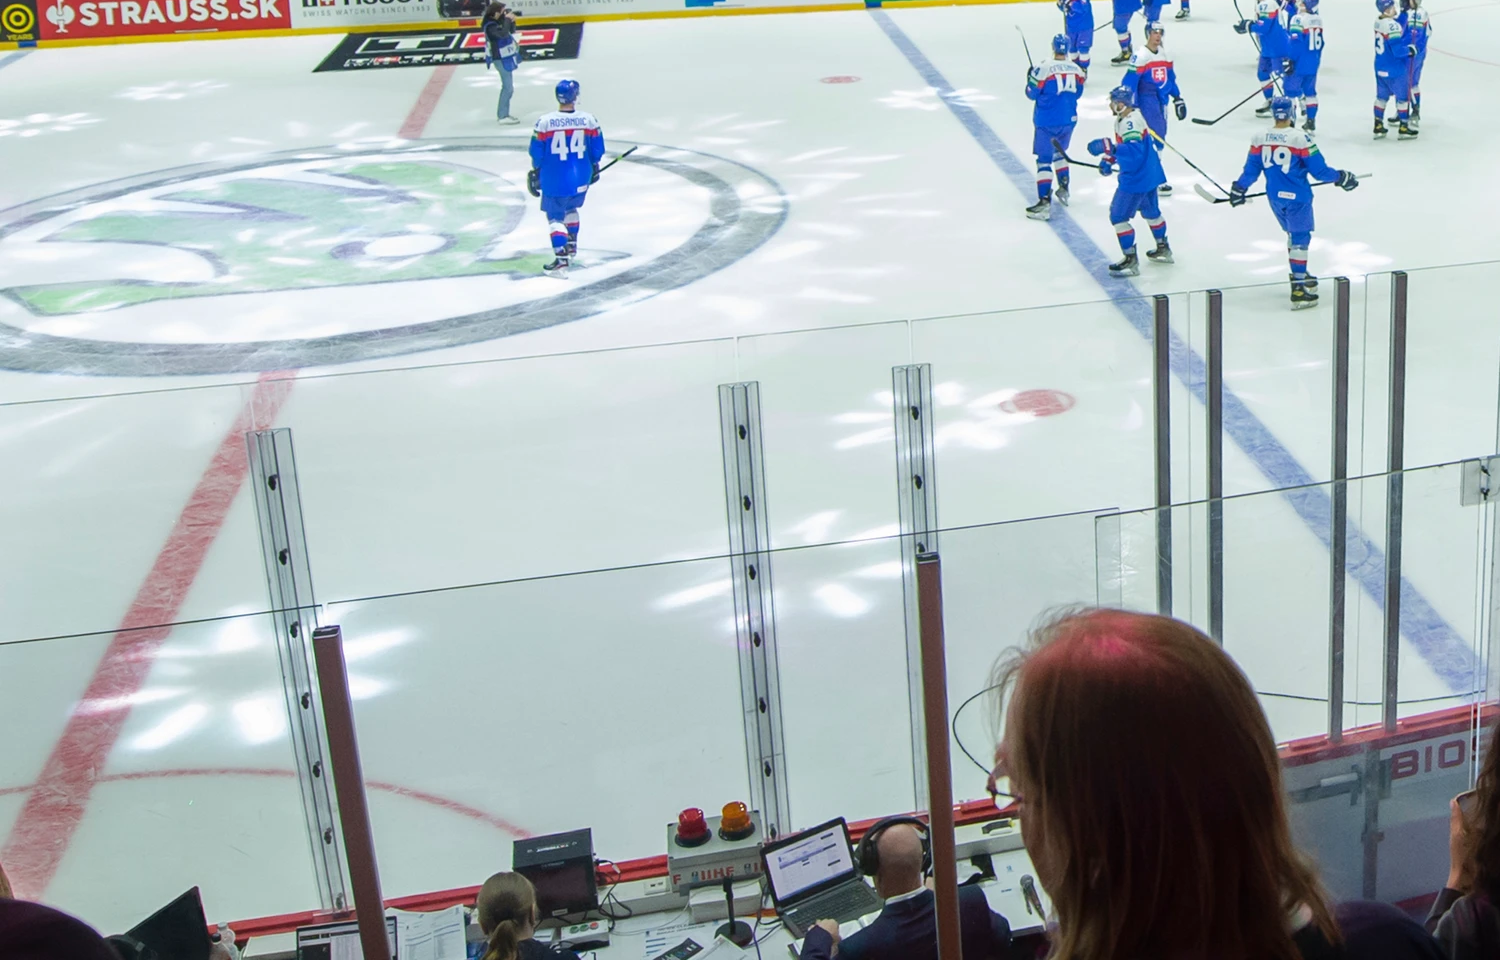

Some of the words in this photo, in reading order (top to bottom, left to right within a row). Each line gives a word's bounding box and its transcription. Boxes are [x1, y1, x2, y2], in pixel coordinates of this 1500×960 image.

[511, 0, 539, 9] SWISS
[303, 10, 332, 19] SWISS
[335, 8, 377, 17] WATCHES
[381, 5, 407, 14] SINCE
[6, 33, 35, 41] YEARS
[1308, 28, 1323, 51] 16
[1054, 73, 1077, 95] 14
[1126, 120, 1134, 131] 3
[551, 129, 587, 161] 44
